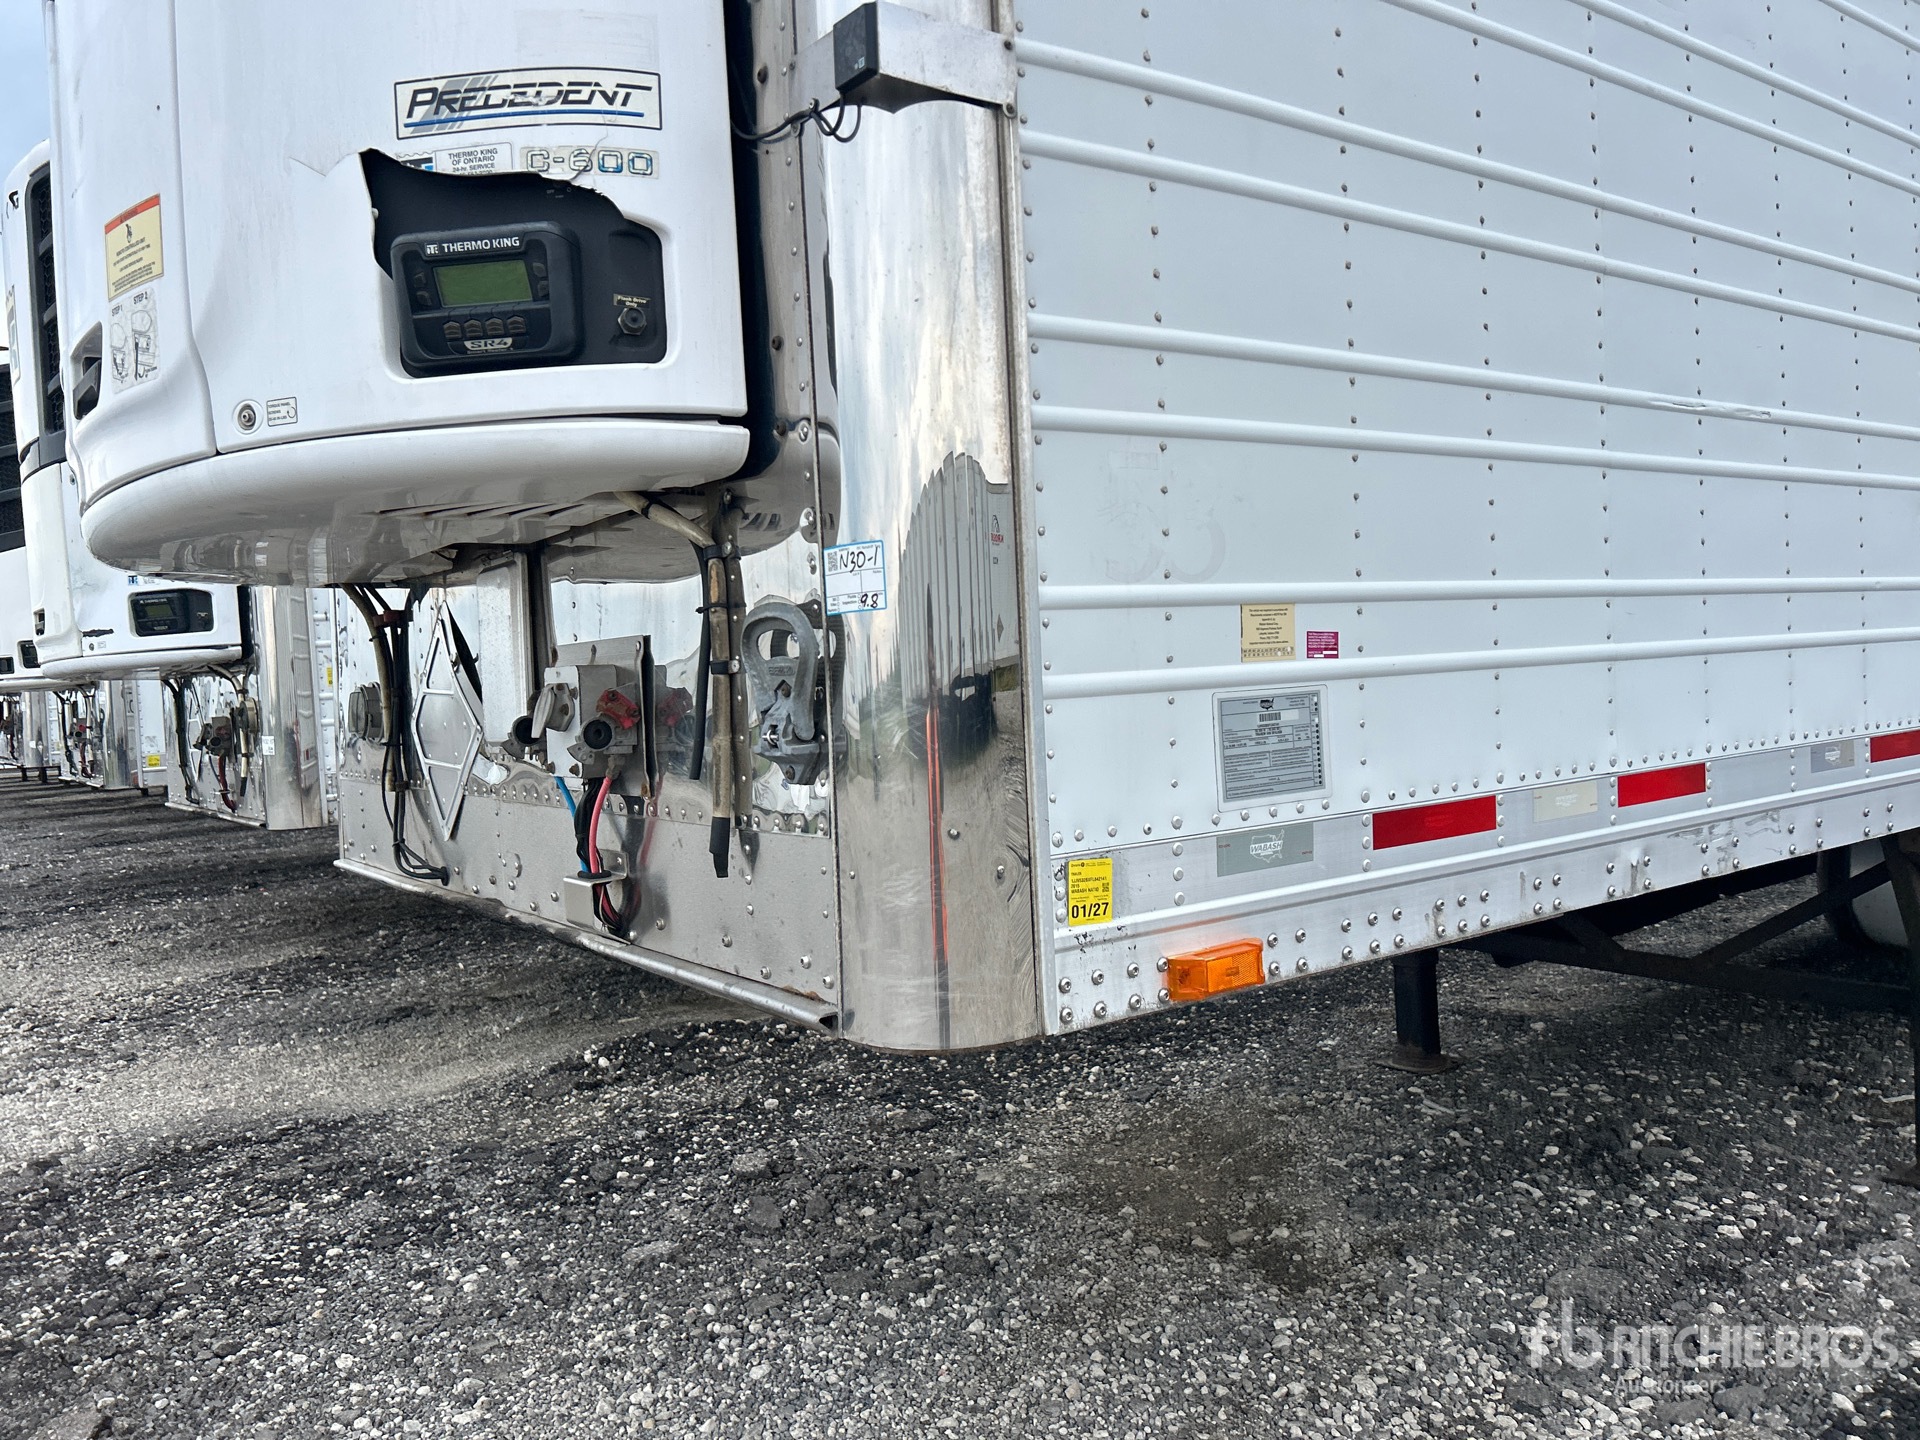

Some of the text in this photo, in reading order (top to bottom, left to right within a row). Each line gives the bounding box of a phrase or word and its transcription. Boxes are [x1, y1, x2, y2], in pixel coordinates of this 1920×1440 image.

[407, 81, 653, 119] PRECEDENT
[448, 148, 498, 160] THERMO KING
[463, 155, 496, 164] ONTARIO
[527, 148, 653, 176] C-600
[469, 162, 496, 171] SERVICE
[442, 239, 491, 253] THERMO
[492, 237, 520, 249] KING
[470, 339, 509, 349] SR4
[839, 546, 878, 573] N30-1
[860, 593, 879, 609] 9.8
[1250, 842, 1283, 853] WABASH
[1071, 902, 1109, 919] 01/27
